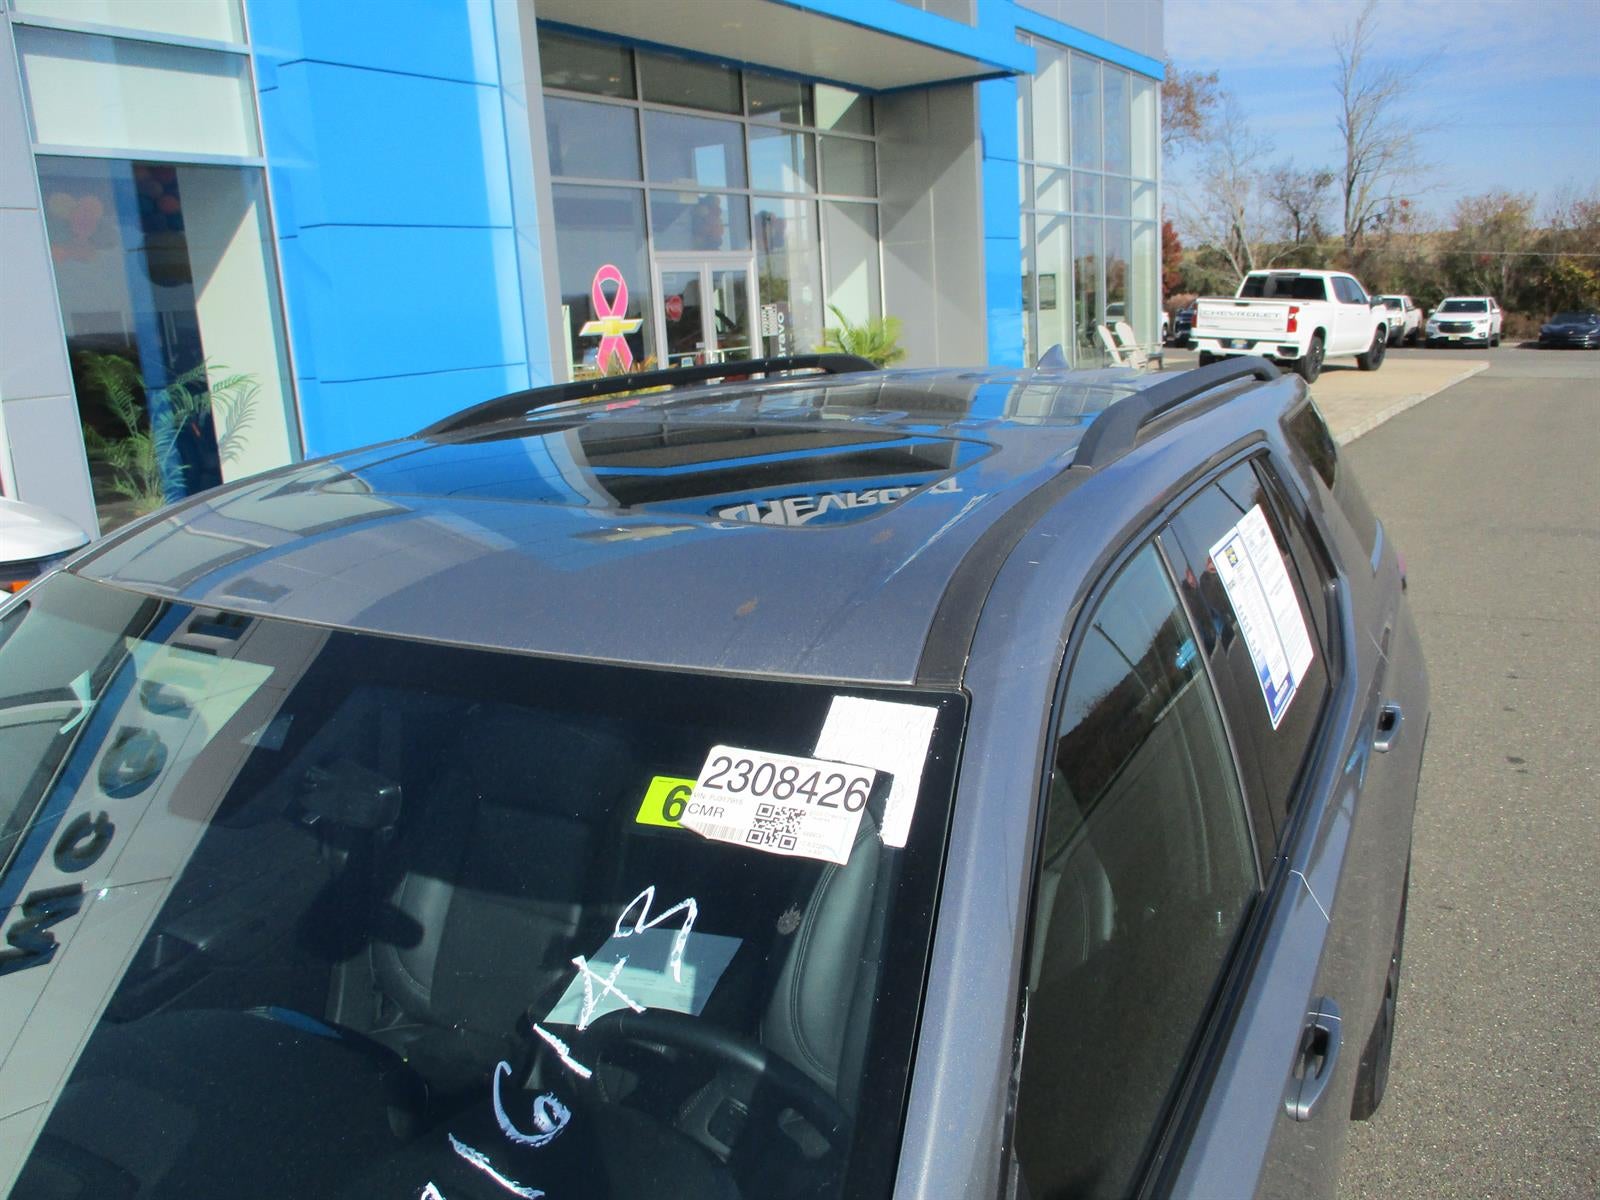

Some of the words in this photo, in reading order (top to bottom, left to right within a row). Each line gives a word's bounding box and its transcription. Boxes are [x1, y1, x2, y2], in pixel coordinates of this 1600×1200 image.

[1203, 310, 1280, 318] CHEVROLET
[702, 755, 871, 813] 2308426
[662, 784, 693, 823] 6
[687, 801, 725, 819] CMR
